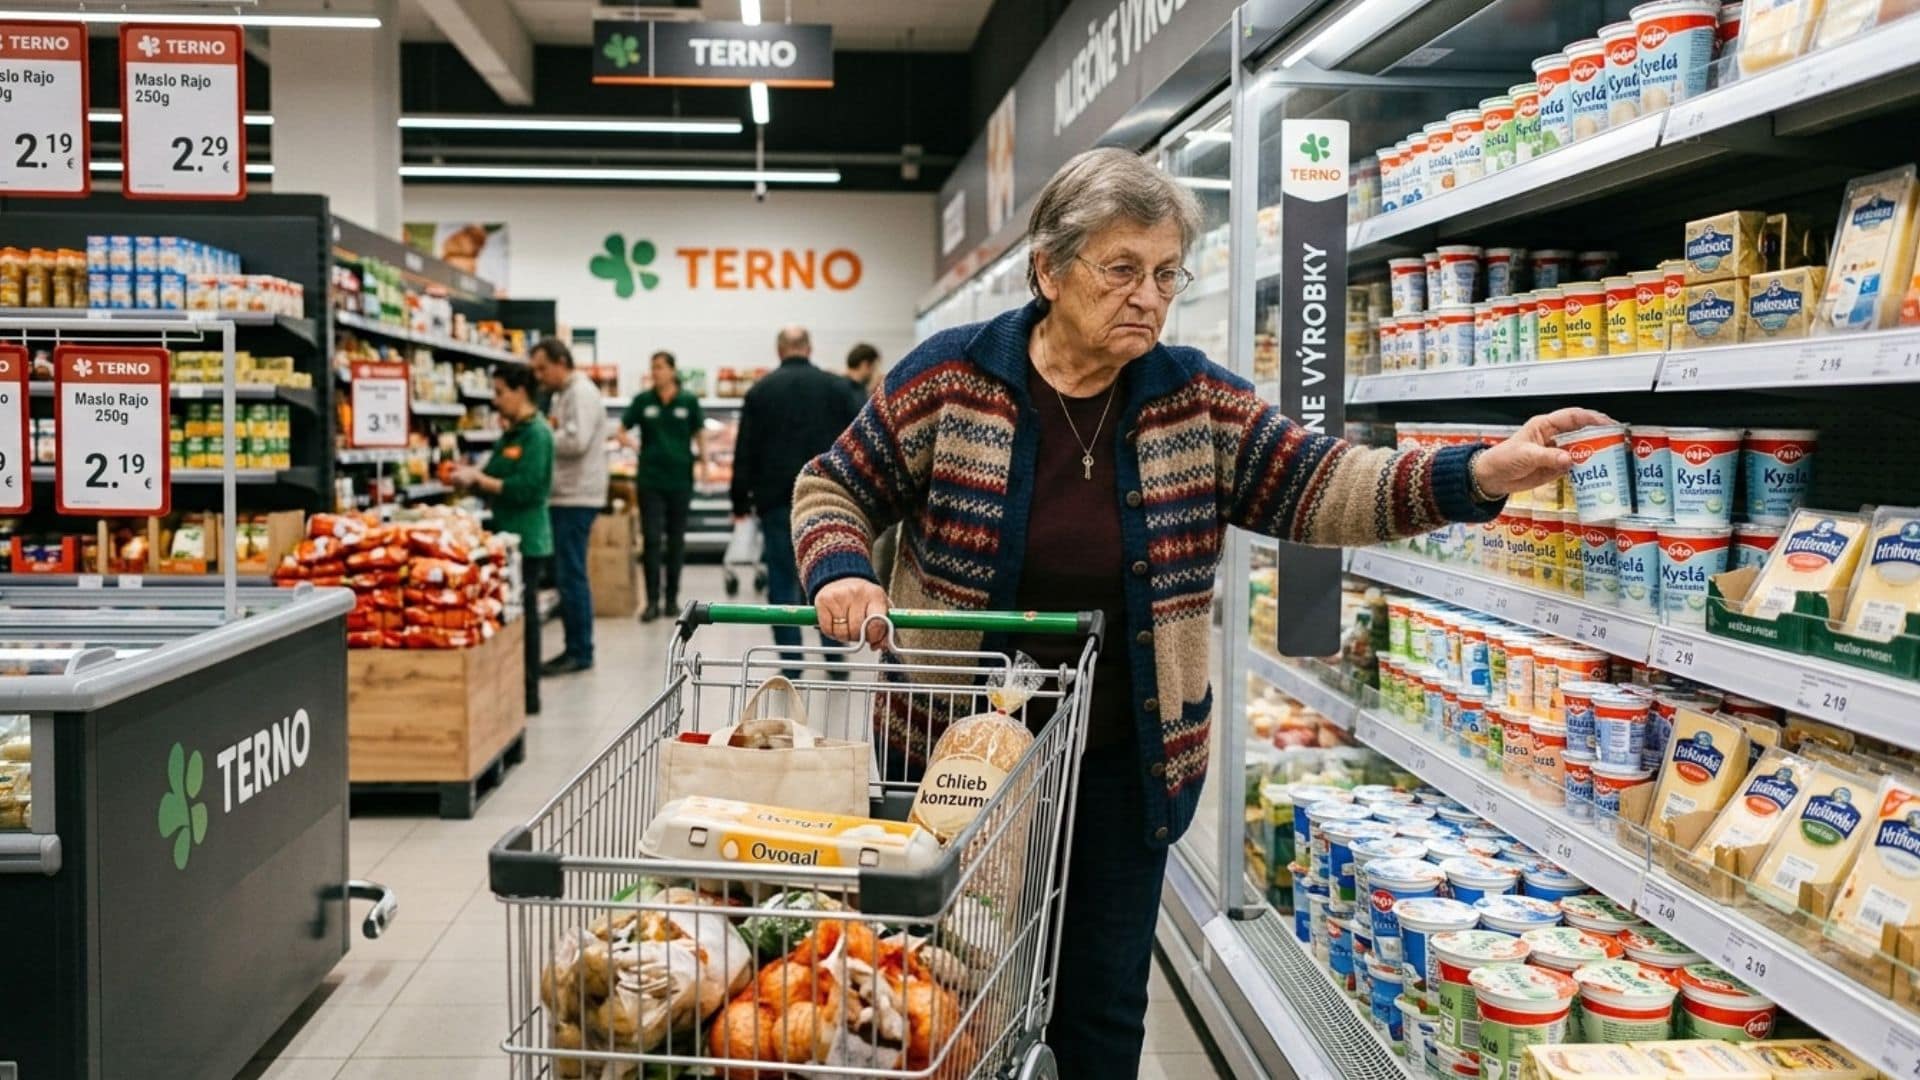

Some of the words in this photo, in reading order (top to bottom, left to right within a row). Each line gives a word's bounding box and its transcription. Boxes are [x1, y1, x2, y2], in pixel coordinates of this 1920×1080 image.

[9, 35, 69, 50] TERNO
[166, 39, 226, 56] TERNO
[687, 38, 797, 68] TERNO
[24, 70, 54, 86] Rajo
[135, 73, 176, 87] Maslo
[180, 74, 211, 90] Rajo
[135, 90, 170, 106] 250g
[15, 133, 72, 168] 2.19
[171, 136, 228, 171] 2.29
[67, 157, 75, 169] €
[222, 161, 230, 173] €
[1291, 168, 1341, 181] TERNO
[675, 247, 864, 291] TERNO
[1296, 243, 1327, 388] VÝROBKY
[97, 362, 150, 375] TERNO
[75, 392, 115, 406] Maslo
[119, 393, 149, 409] Rajo
[95, 409, 129, 426] 250g
[85, 453, 145, 488] 2.19
[144, 477, 152, 490] €
[217, 708, 311, 813] TERNO
[936, 773, 988, 791] Chlieb
[920, 789, 991, 808] konzum
